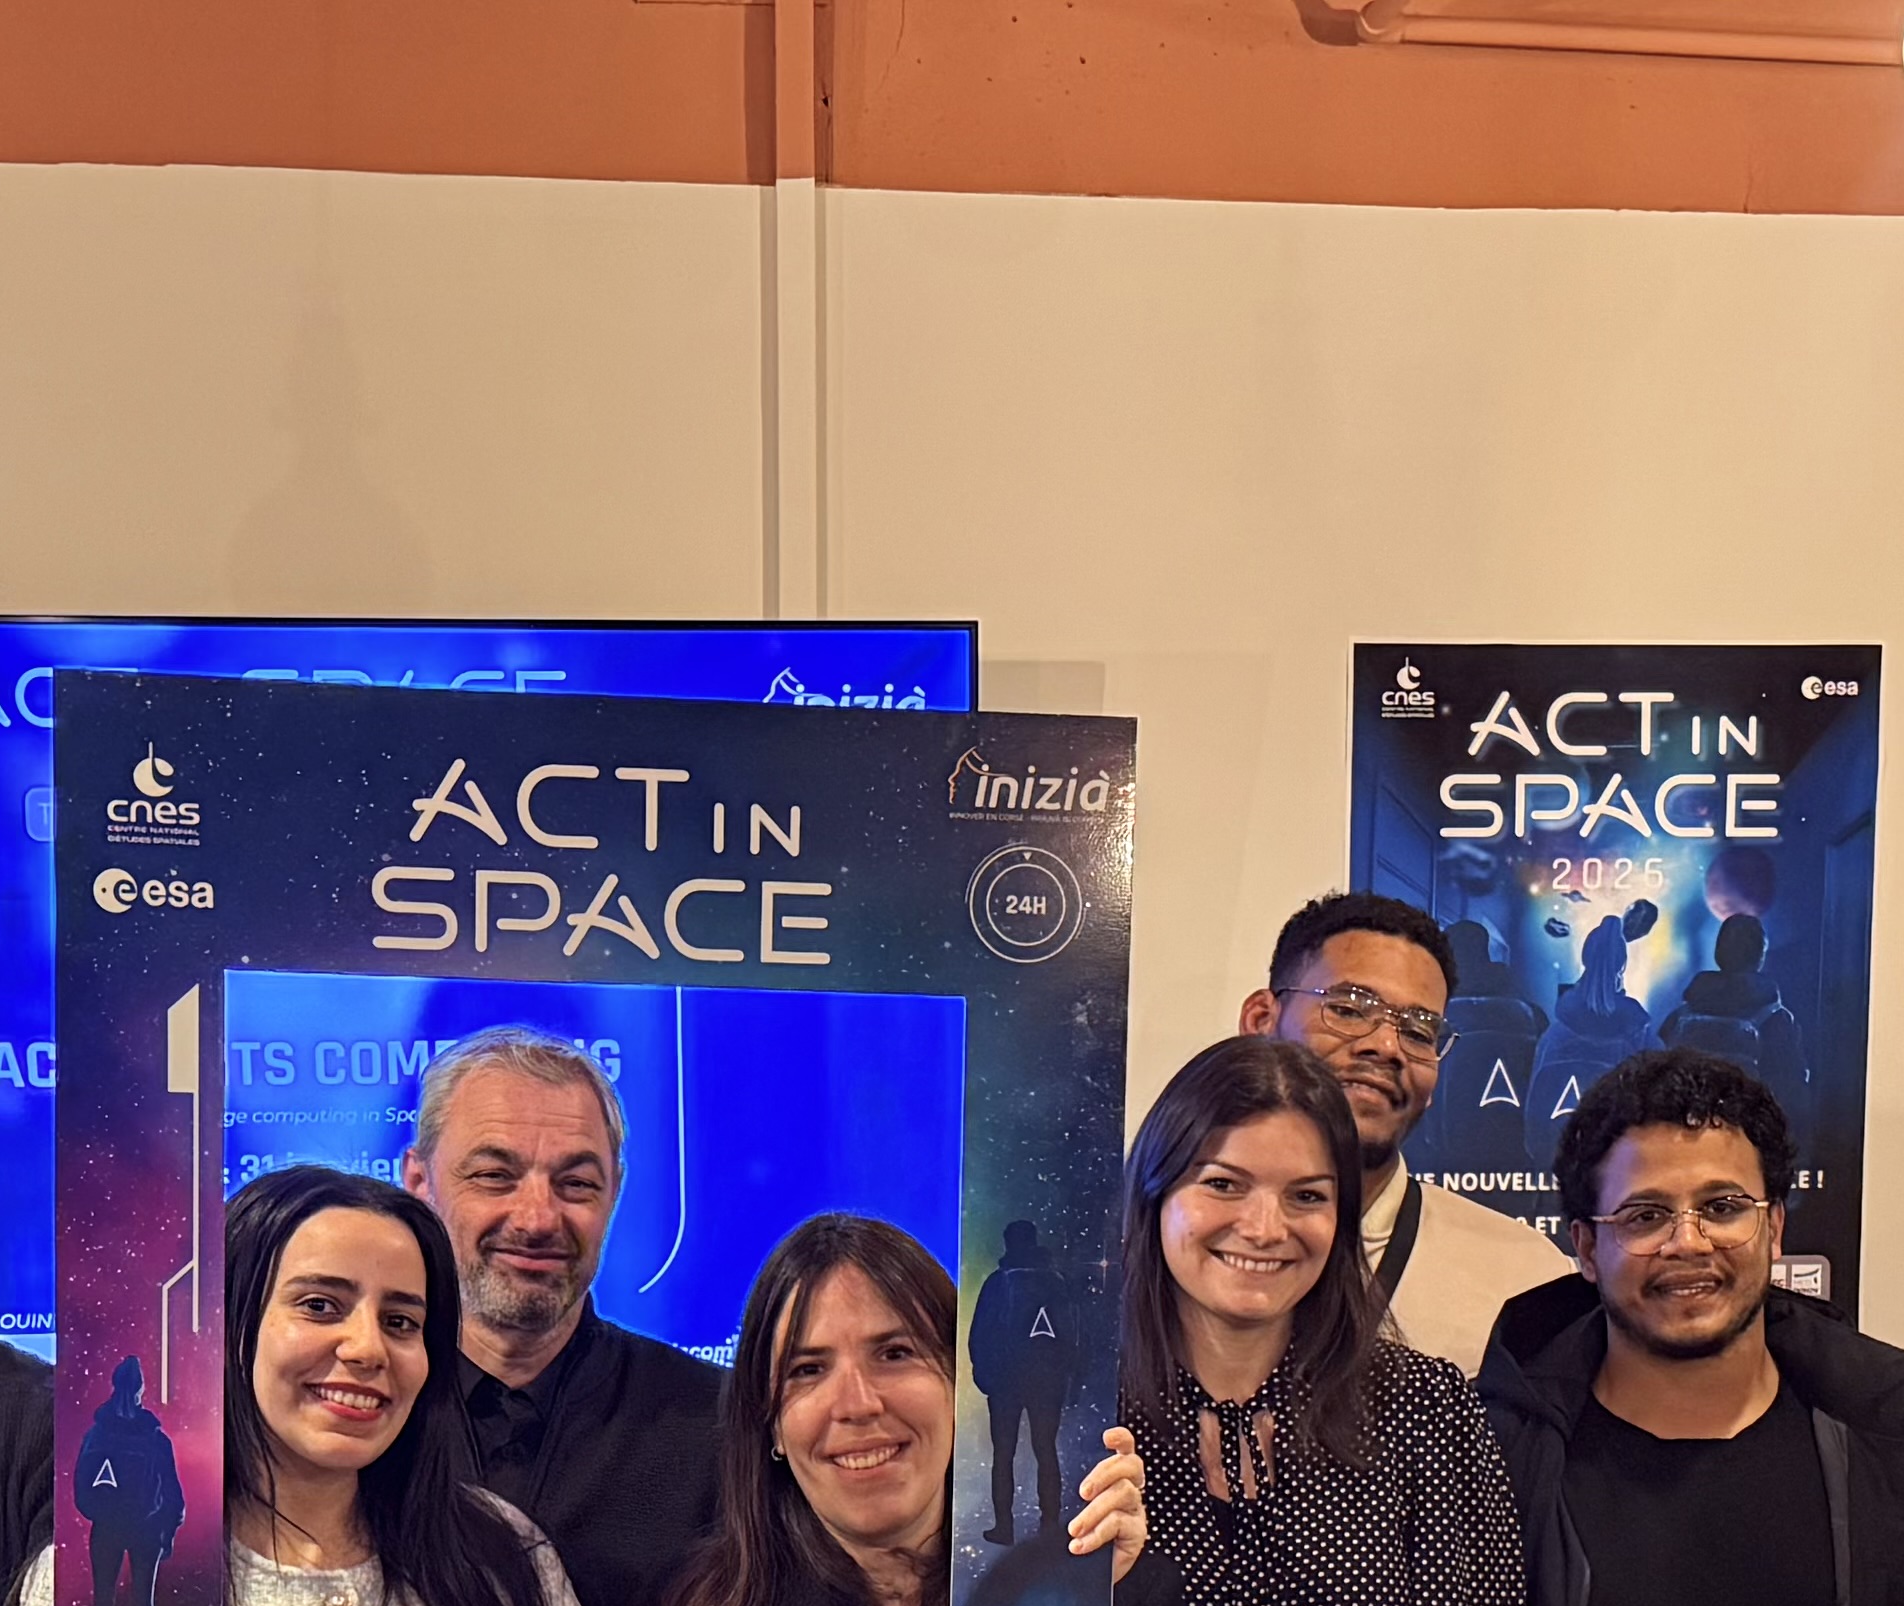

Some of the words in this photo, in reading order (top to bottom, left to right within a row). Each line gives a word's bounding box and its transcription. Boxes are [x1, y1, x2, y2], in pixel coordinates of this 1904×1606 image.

[1381, 691, 1436, 706] cnes
[1823, 679, 1859, 697] esa
[1468, 690, 1675, 756] ACT
[1691, 715, 1758, 757] IN
[974, 764, 1111, 811] inizià
[107, 799, 201, 825] cnes
[409, 758, 691, 852] ACT
[713, 802, 802, 857] IN
[1439, 773, 1781, 838] SPACE
[1552, 857, 1664, 890] 2026
[142, 880, 215, 909] esa
[1005, 895, 1047, 915] 24H
[371, 866, 833, 964] SPACE
[252, 1107, 358, 1126] computing
[363, 1107, 380, 1122] in
